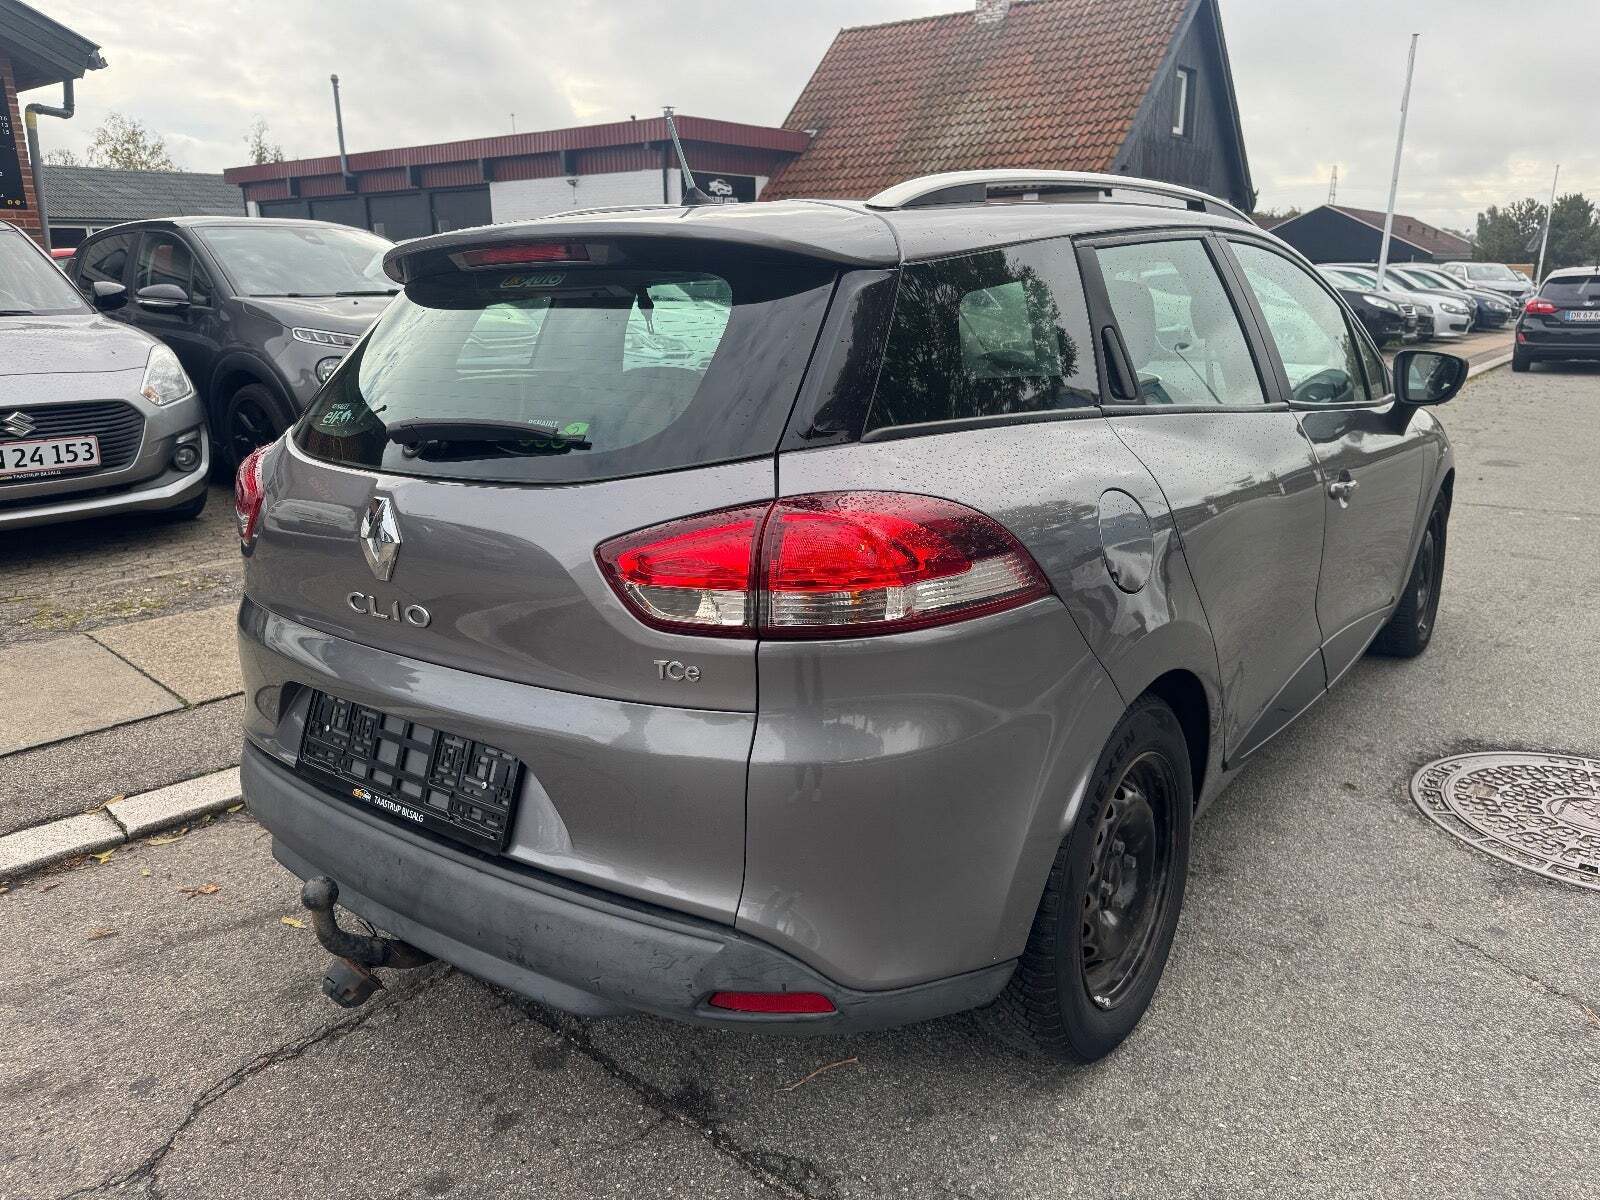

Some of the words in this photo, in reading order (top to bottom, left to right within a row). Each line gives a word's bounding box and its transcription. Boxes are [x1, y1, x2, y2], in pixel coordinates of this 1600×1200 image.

[12, 446, 44, 468] 24
[51, 442, 95, 464] 153
[346, 591, 431, 628] CLIO
[653, 659, 700, 682] TCe
[374, 795, 402, 813] TAASTRUP
[401, 807, 424, 823] BILSALG
